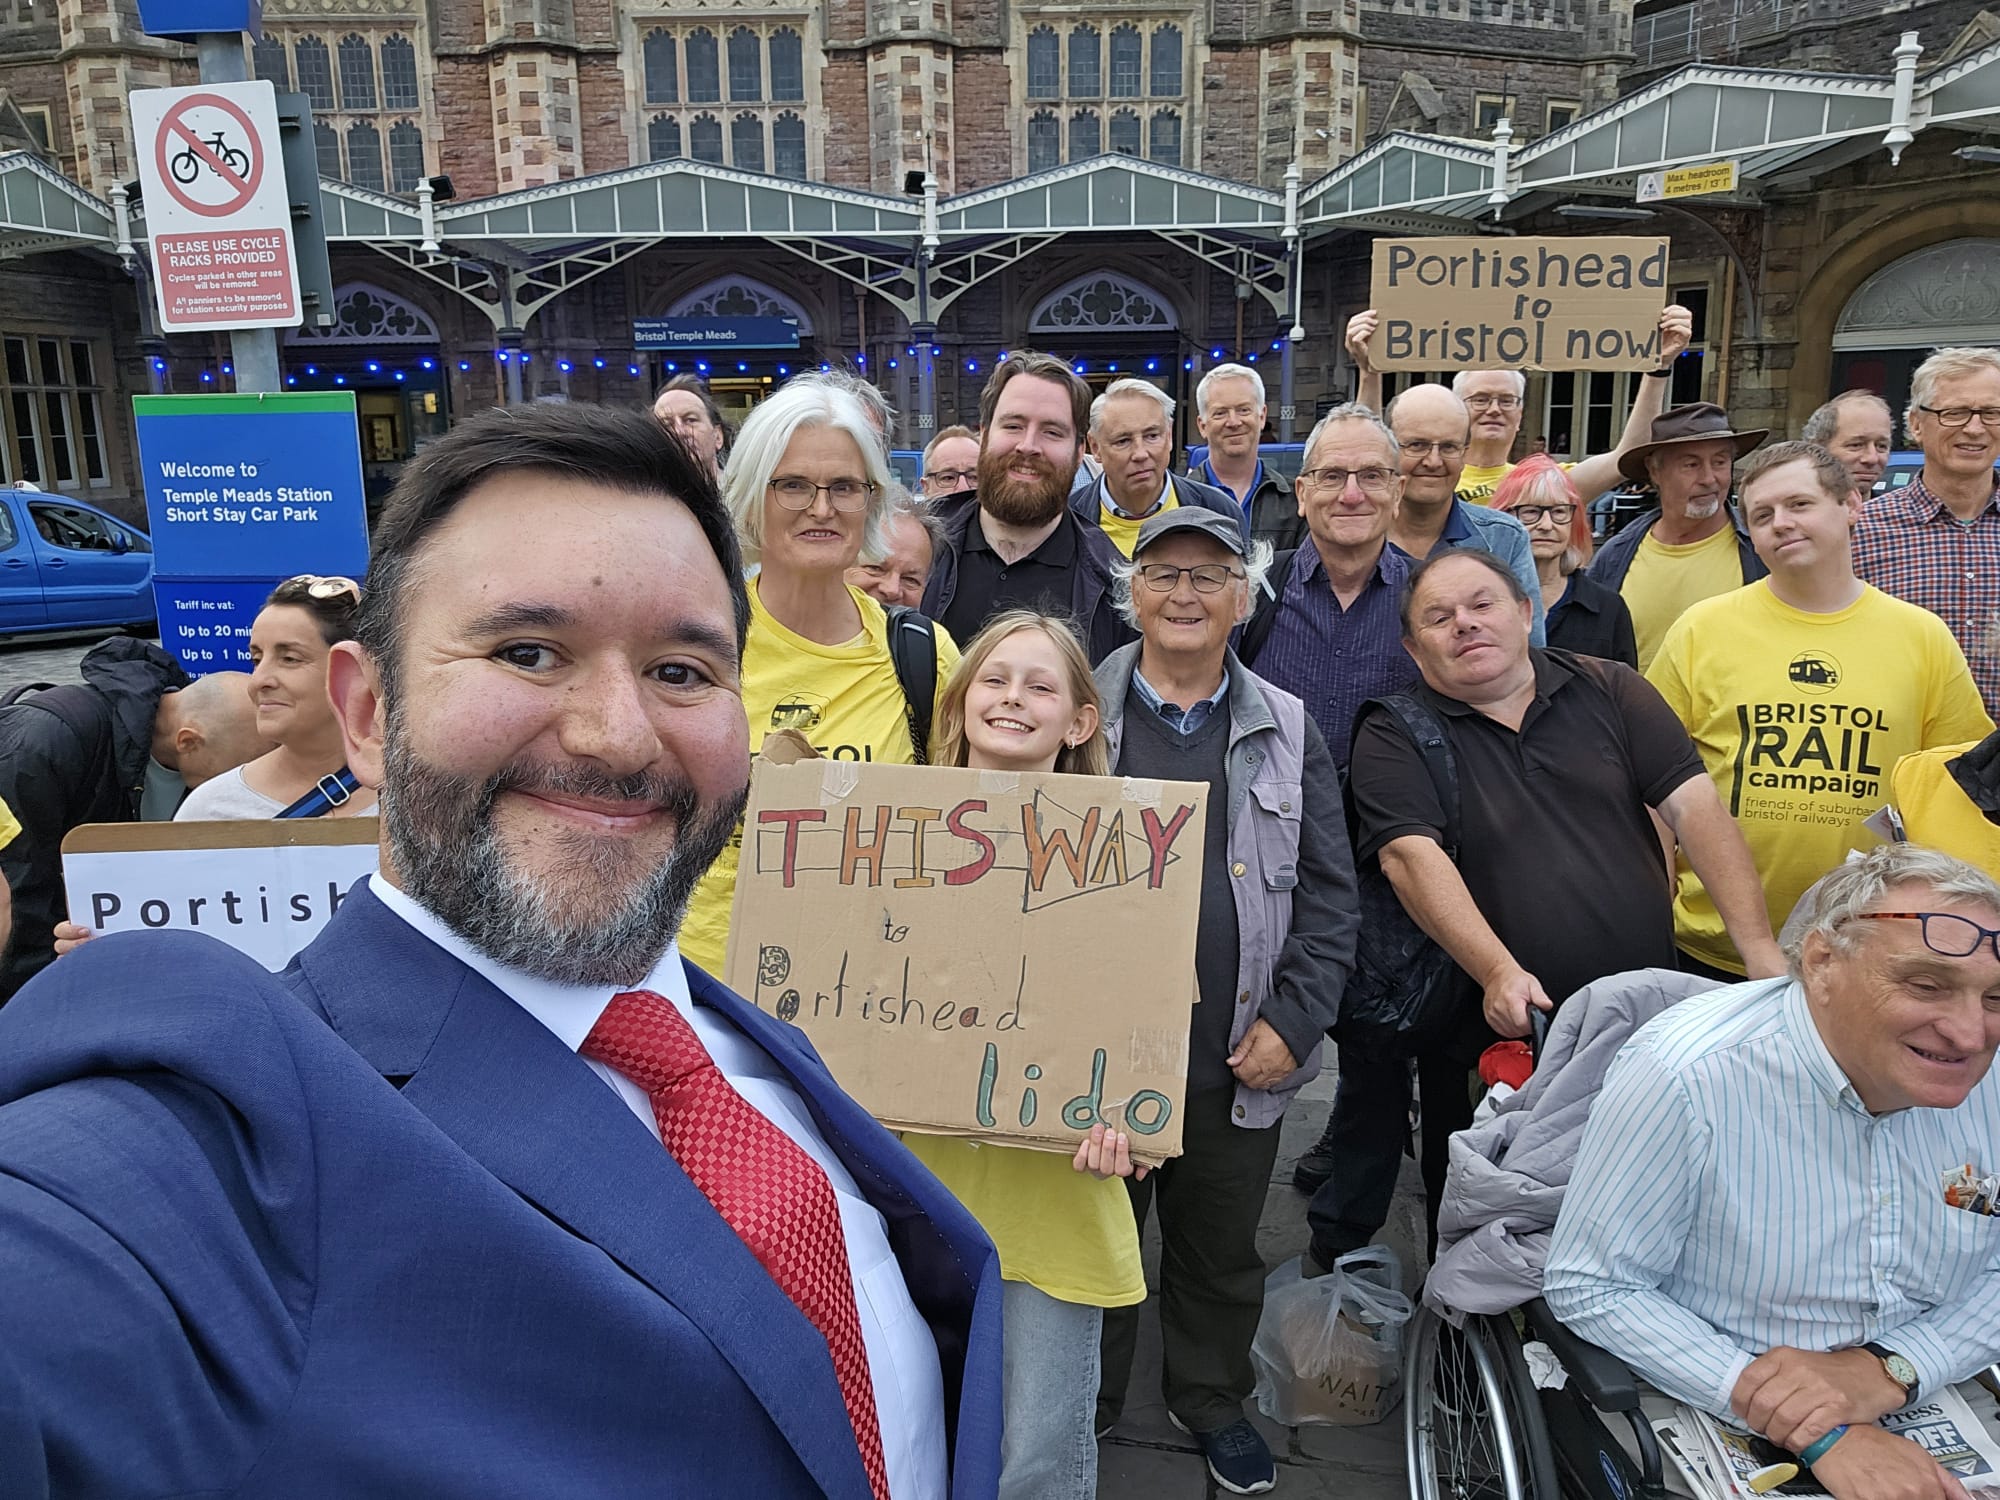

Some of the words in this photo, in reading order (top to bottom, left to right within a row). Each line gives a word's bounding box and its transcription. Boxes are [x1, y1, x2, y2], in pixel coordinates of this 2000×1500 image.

[1688, 167, 1730, 179] headroom
[1673, 182, 1702, 193] metres
[161, 240, 210, 254] PLEASE
[212, 239, 237, 252] USE
[240, 236, 281, 250] CYCLE
[170, 255, 212, 268] RACKS
[215, 251, 276, 265] PROVIDED
[1387, 244, 1667, 290] Portishead
[168, 273, 196, 283] Cycles
[198, 271, 225, 282] parked
[227, 271, 235, 279] in
[236, 270, 258, 279] other
[260, 270, 283, 278] areas
[194, 282, 208, 290] will
[210, 281, 221, 289] be
[222, 279, 259, 289] removed.
[172, 307, 184, 315] for
[186, 305, 214, 314] station
[215, 303, 248, 313] security
[250, 302, 288, 312] purposes
[188, 295, 222, 306] panniers
[224, 295, 233, 303] to
[234, 294, 245, 303] be
[1513, 294, 1552, 320] to
[634, 331, 667, 342] Bristol
[667, 331, 704, 342] Temple
[705, 330, 737, 340] Meads
[1386, 320, 1545, 365] Bristol
[1565, 322, 1663, 364] now!
[160, 462, 236, 478] Welcome
[240, 462, 258, 477] to
[162, 488, 219, 505] Temple
[222, 488, 273, 502] Meads
[277, 487, 333, 502] Station
[166, 507, 209, 522] Short
[213, 507, 247, 524] Stay
[251, 507, 278, 521] Car
[283, 507, 318, 521] Park
[174, 600, 199, 610] Tariff
[201, 600, 215, 610] inc
[216, 600, 235, 610] vat:
[178, 625, 196, 638] Up
[198, 626, 210, 637] to
[214, 625, 231, 637] 20
[182, 649, 198, 661] Up
[201, 649, 213, 660] to
[223, 649, 229, 660] 1
[1753, 703, 1890, 732] BRISTOL
[1750, 725, 1881, 776] RAIL
[1748, 770, 1879, 799] campaign
[1745, 796, 1794, 810] friends
[1798, 801, 1815, 812] of
[1744, 808, 1789, 821] bristol
[1793, 812, 1851, 828] railways
[757, 799, 997, 888] THIS
[1021, 803, 1197, 892] WAY
[884, 919, 911, 943] to
[754, 942, 1027, 1032] Portishead
[975, 1041, 1173, 1136] lido
